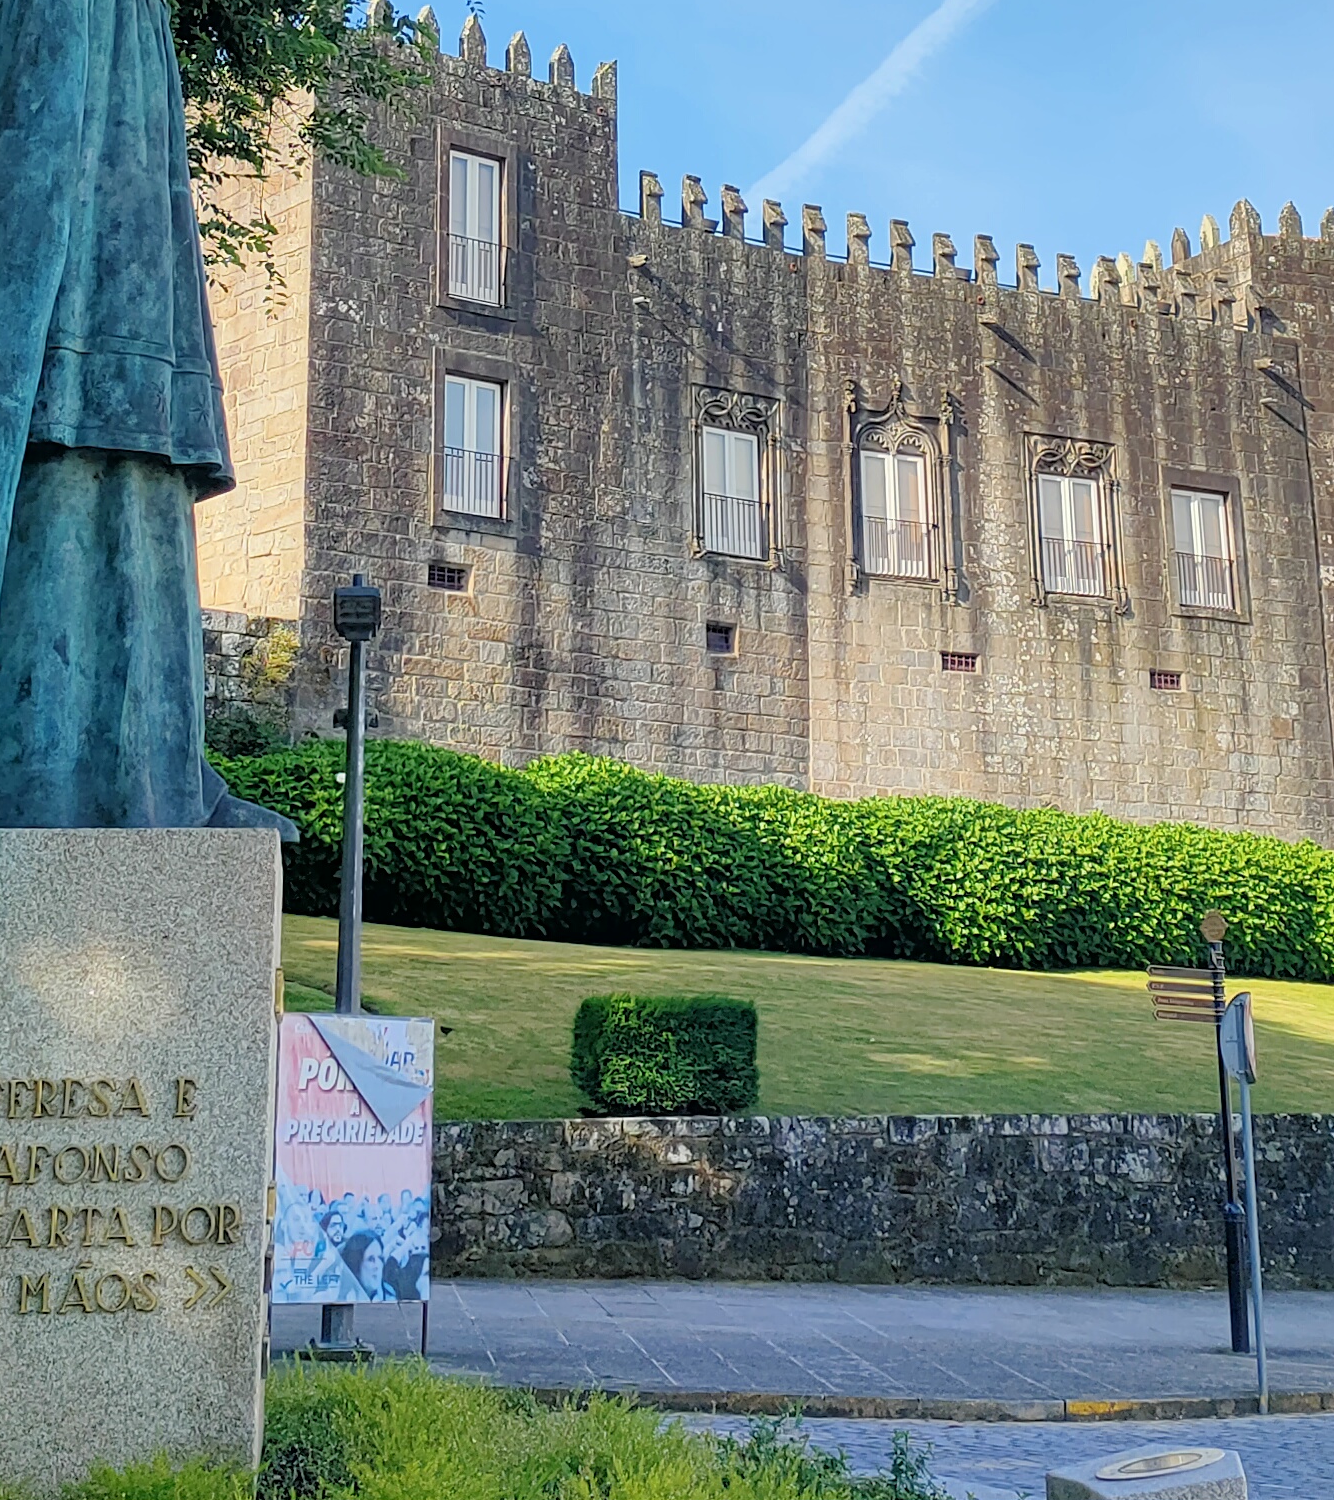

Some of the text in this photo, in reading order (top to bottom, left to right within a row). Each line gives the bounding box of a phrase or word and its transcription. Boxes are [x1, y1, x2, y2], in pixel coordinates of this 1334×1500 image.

[172, 1077, 200, 1119] E
[151, 1203, 244, 1246] POR
[17, 1260, 162, 1315] MÃOS
